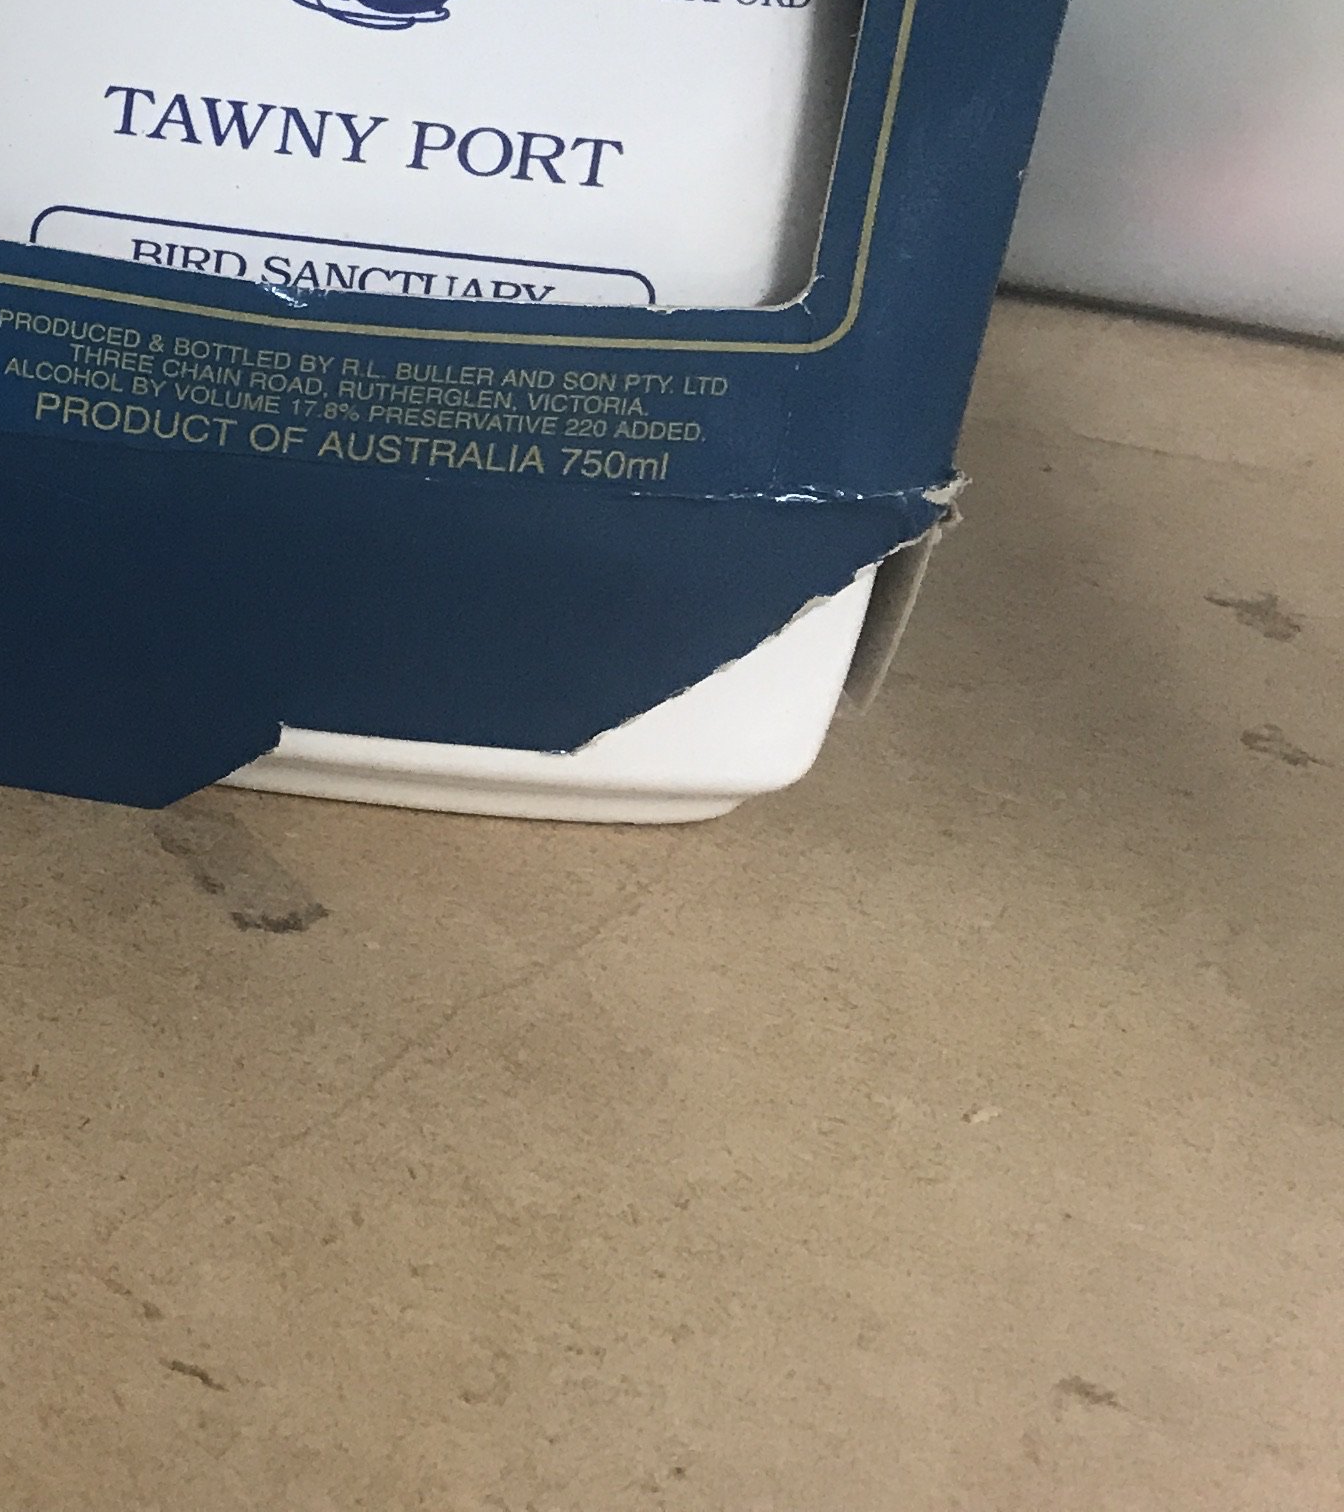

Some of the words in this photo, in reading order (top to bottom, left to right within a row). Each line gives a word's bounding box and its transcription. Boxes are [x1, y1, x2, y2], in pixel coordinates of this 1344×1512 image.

[104, 84, 389, 164] TAWNY
[405, 120, 624, 189] PORT
[4, 357, 123, 393] ALCOHOL
[132, 377, 167, 397] BY
[175, 382, 280, 414] VOLUME
[291, 399, 360, 422] 17.8%
[368, 405, 559, 436] PRESERVATIVE
[565, 418, 607, 438] 220
[613, 419, 706, 443] ADDED.
[69, 343, 154, 374] THREE
[163, 358, 241, 387] CHAIN
[528, 392, 649, 417] VICTORIA.
[149, 333, 164, 352] &
[174, 337, 290, 370] BOTTLED
[300, 355, 335, 374] BY
[342, 358, 386, 378] R.L.
[396, 363, 494, 386] BULLER
[501, 369, 554, 389] AND
[563, 371, 616, 392] SON
[624, 374, 673, 394] PTY.
[683, 376, 728, 396] LTD
[35, 391, 237, 447] PRODUCT
[249, 423, 308, 454] OF
[318, 430, 545, 475] AUSTRALIA
[561, 447, 670, 481] 750ml
